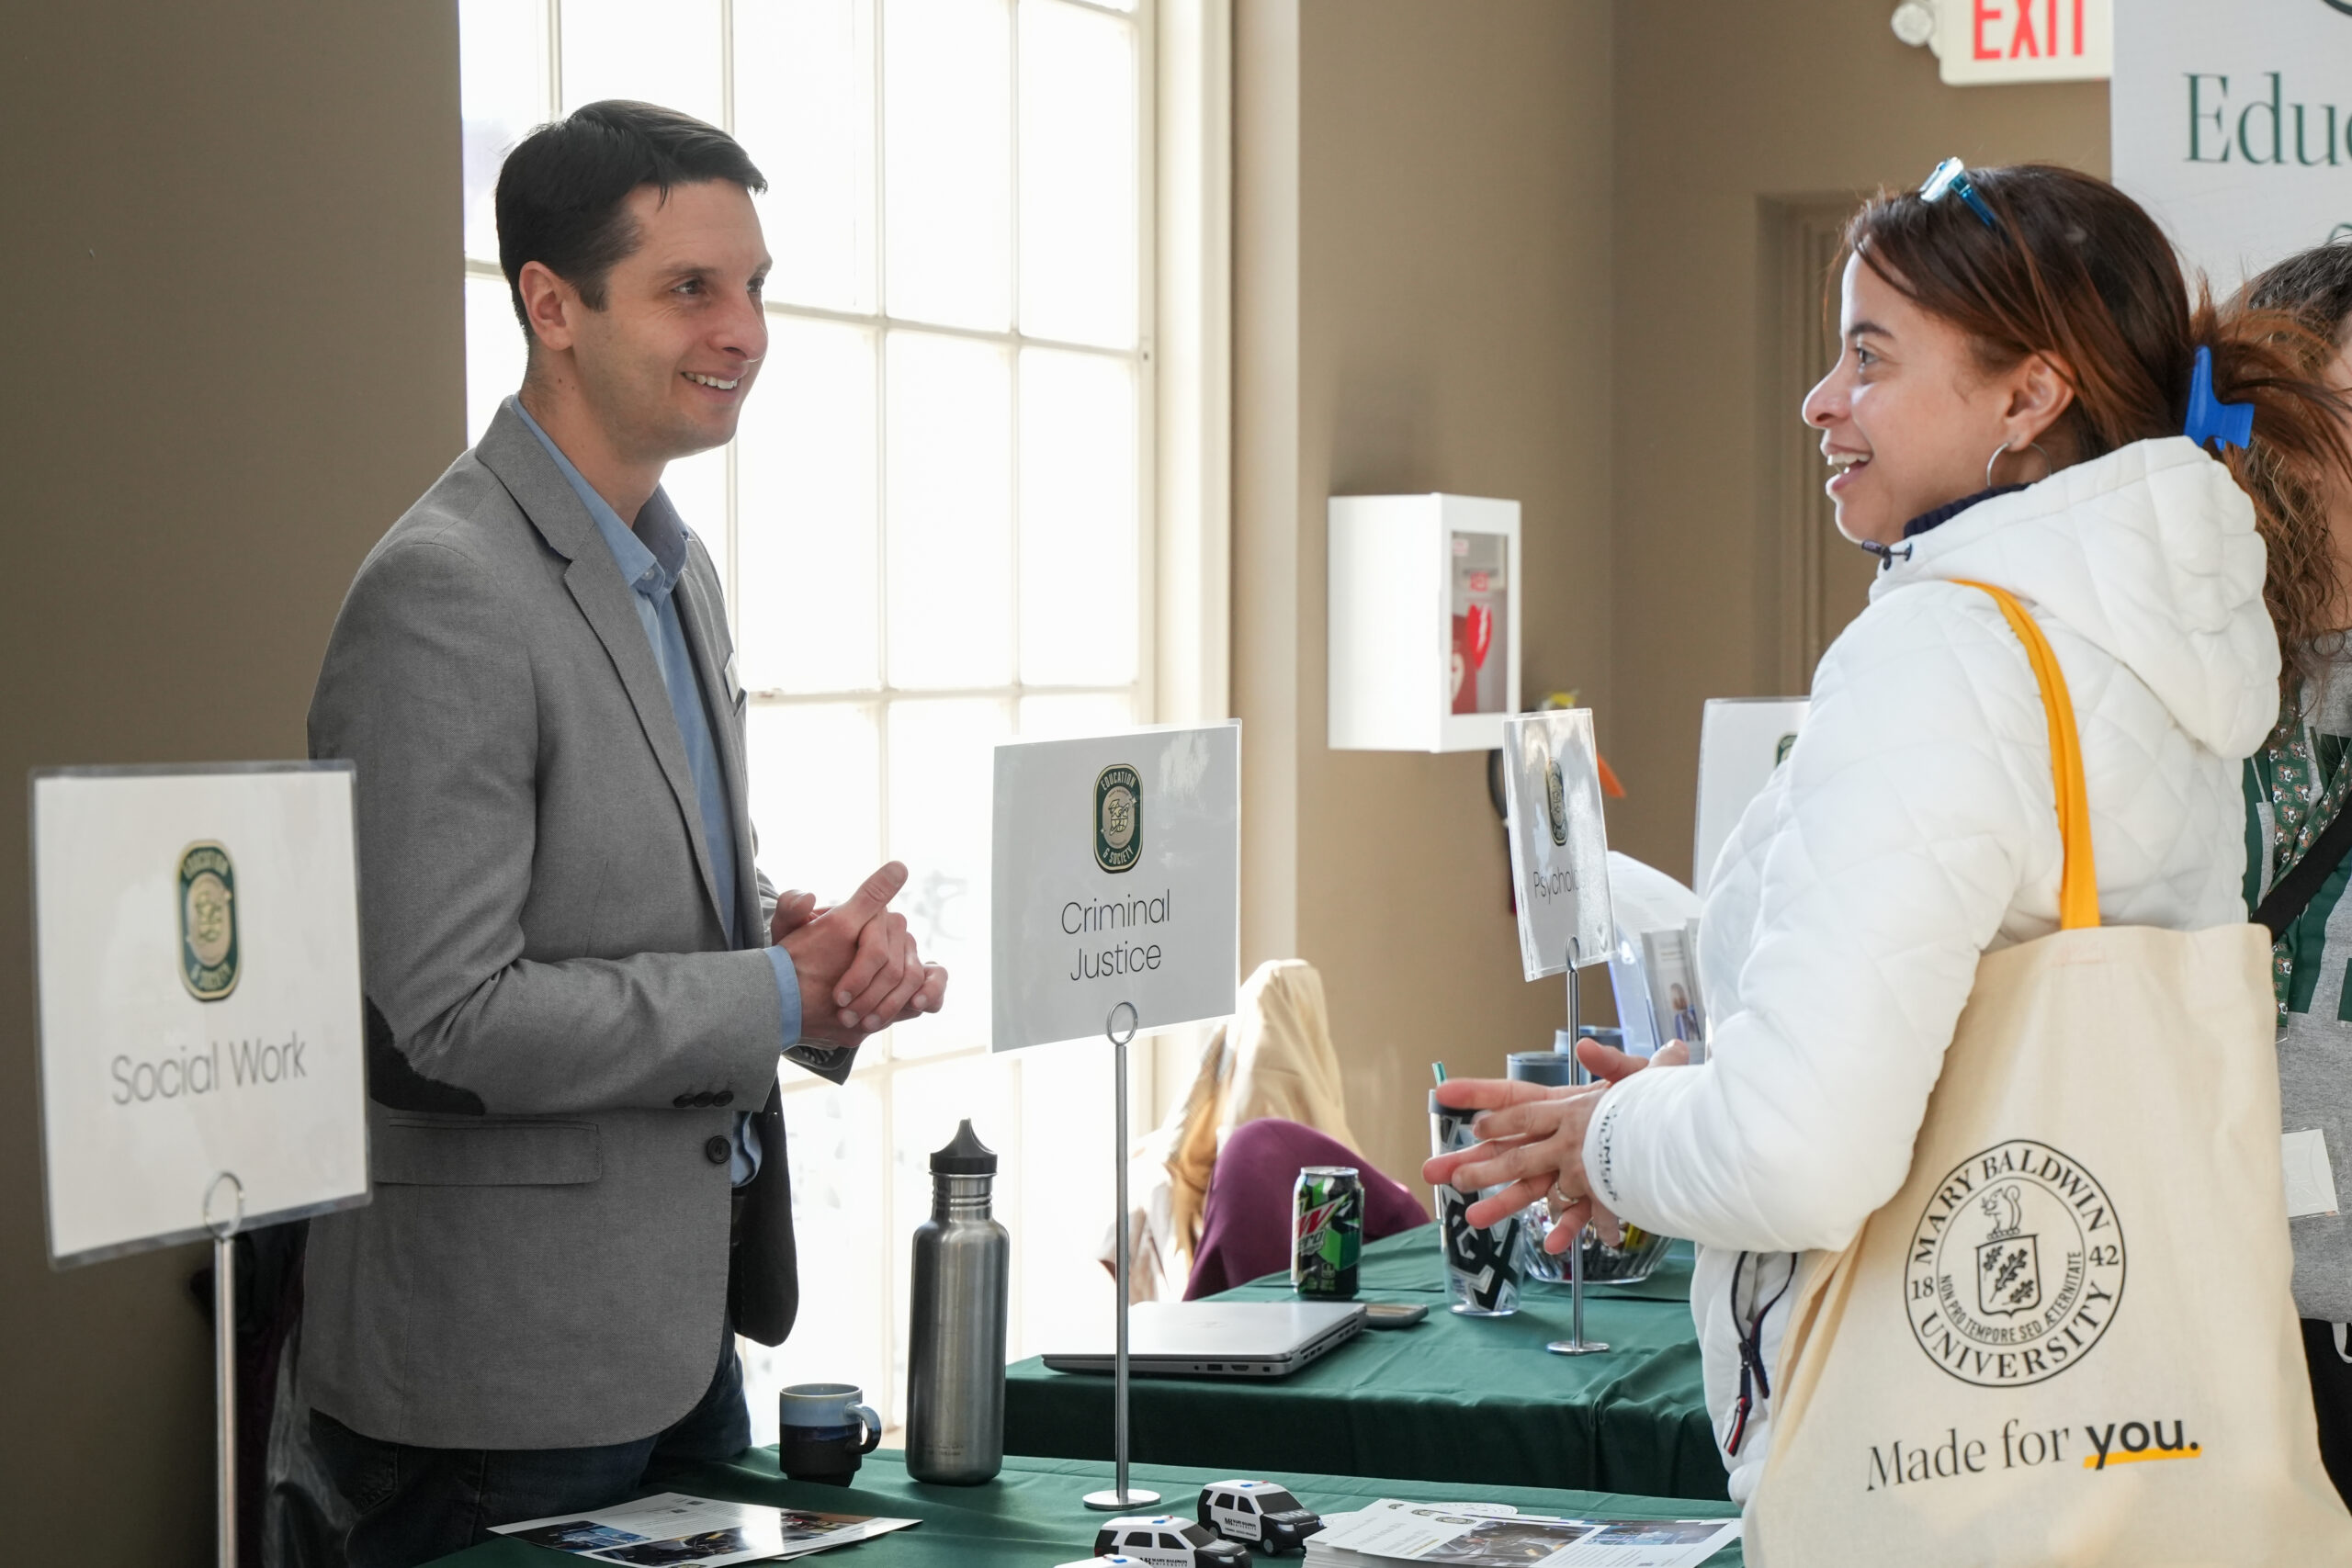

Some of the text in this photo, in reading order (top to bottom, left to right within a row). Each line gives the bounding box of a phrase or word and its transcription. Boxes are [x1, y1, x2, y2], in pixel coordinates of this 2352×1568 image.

[2182, 71, 2352, 166] Edu
[1101, 772, 1136, 790] EDUCATION
[1109, 845, 1134, 864] SOCIETY
[1061, 889, 1170, 934] Criminal
[1070, 941, 1161, 981] Justice
[111, 1031, 307, 1105] Social Work
[1914, 1148, 2110, 1266] MARY BALDWIN
[2088, 1245, 2120, 1267] 42
[1911, 1277, 1935, 1301] 18
[1940, 1274, 1955, 1302] NON
[1949, 1301, 1967, 1325] PRO
[1965, 1317, 2016, 1342] TEMPORE
[2019, 1320, 2042, 1340] SED
[1921, 1280, 2113, 1379] UNIVERSITY
[1866, 1418, 2199, 1492] Made for you.
